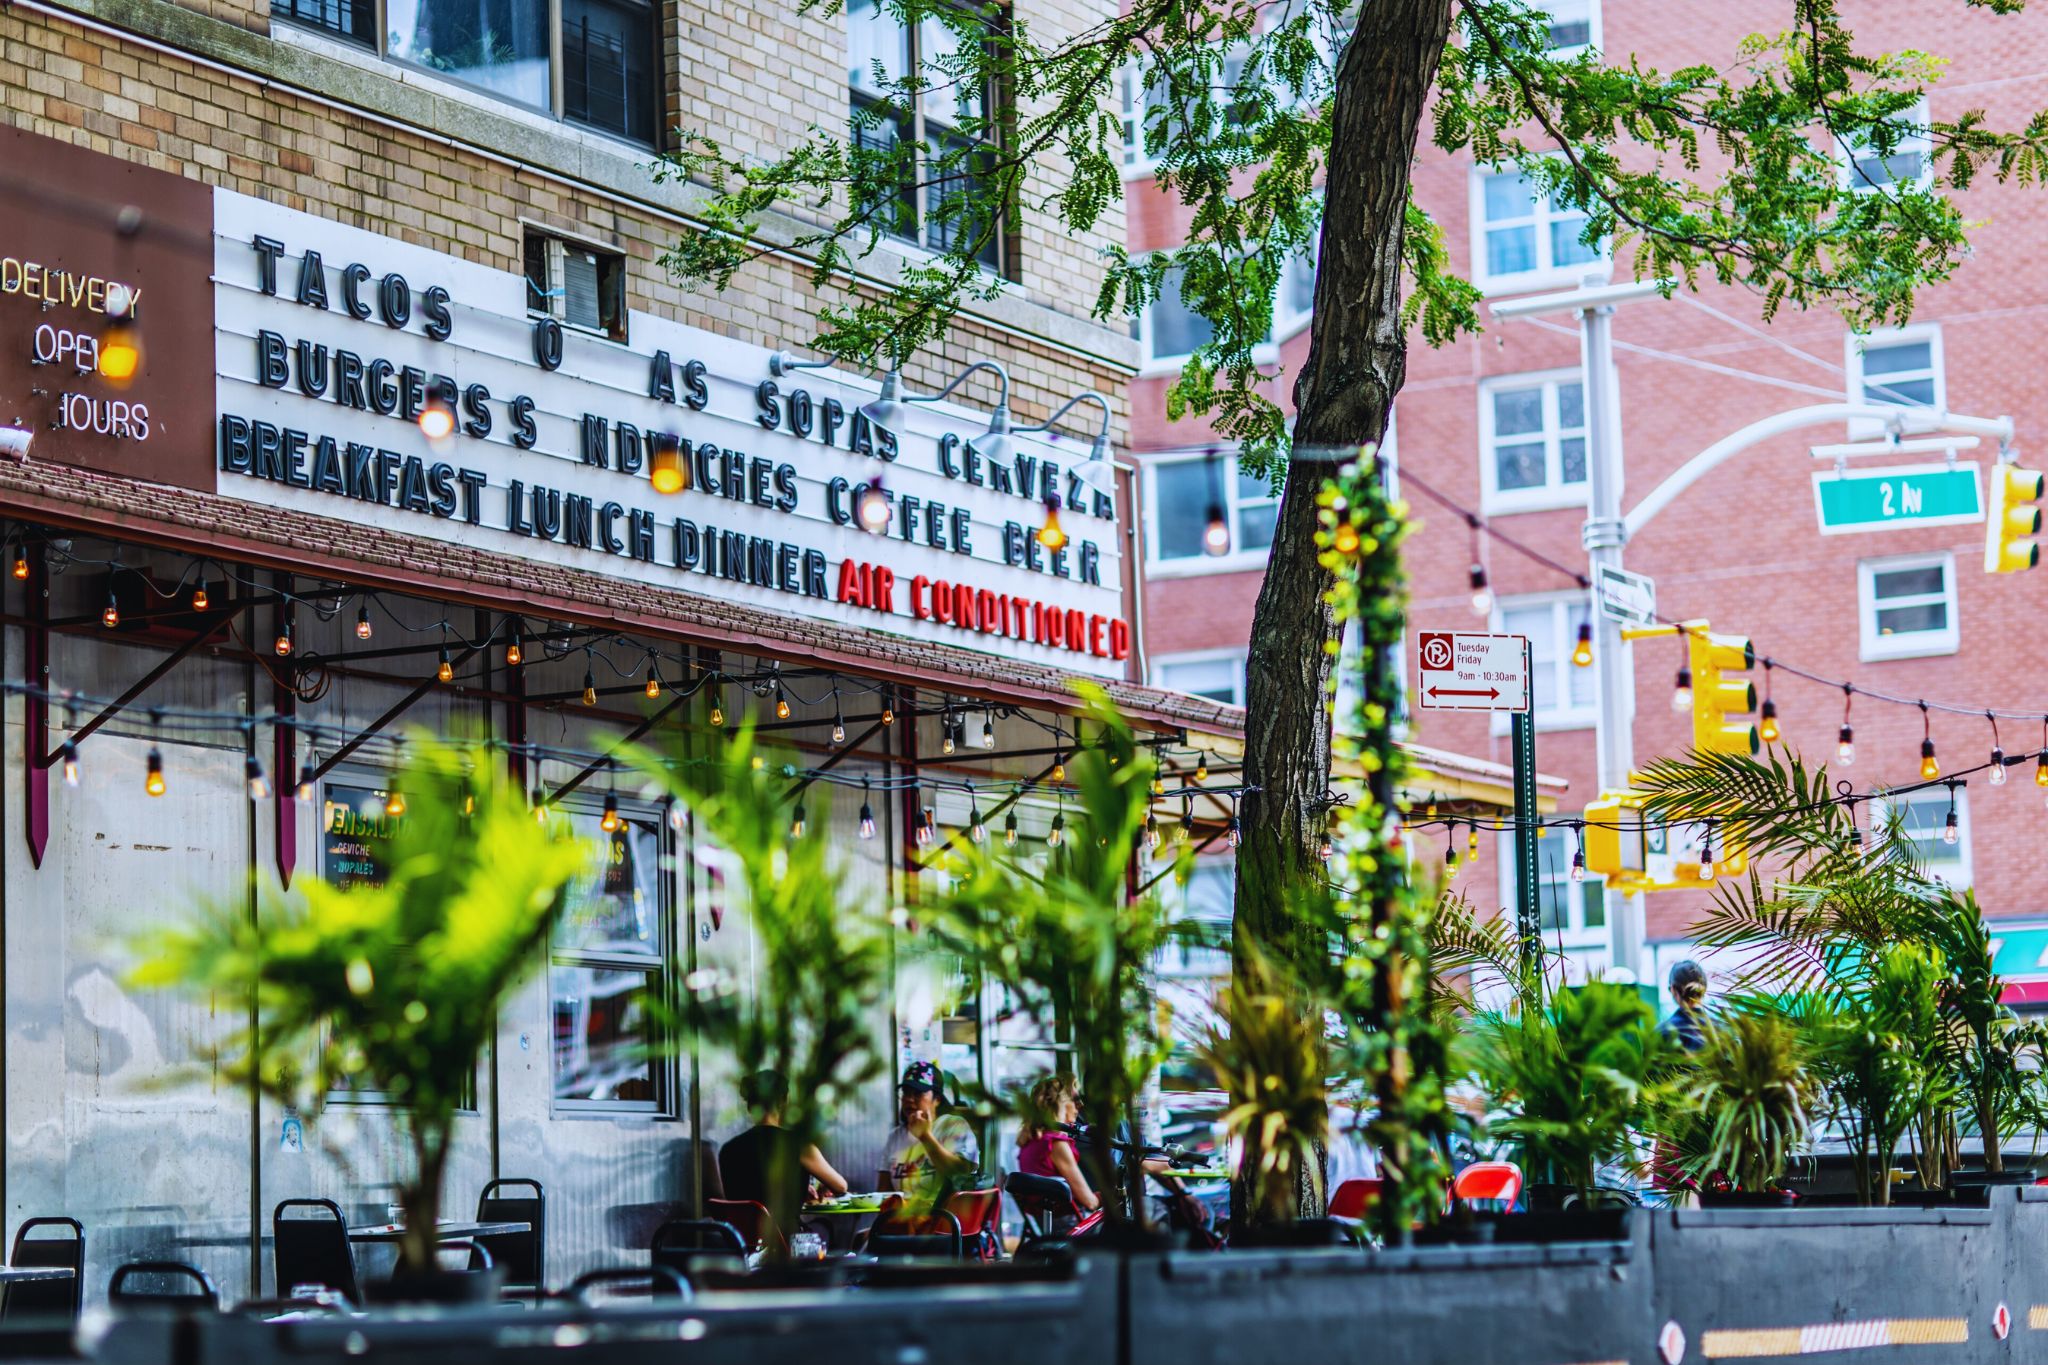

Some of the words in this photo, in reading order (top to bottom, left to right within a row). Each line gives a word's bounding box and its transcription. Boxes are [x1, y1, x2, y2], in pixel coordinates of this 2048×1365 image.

[2, 257, 141, 319] DELIVERY
[253, 234, 452, 342] TACOS
[537, 317, 563, 371] O
[650, 349, 708, 411] AS
[758, 379, 899, 461] SOPAS
[259, 328, 492, 439] BURGERS
[583, 412, 798, 514] NDWICHES
[1004, 520, 1100, 586] BEER
[1879, 481, 1896, 516] 2
[220, 413, 487, 525] BREAKFAST
[510, 479, 656, 563] LUNCH
[674, 517, 828, 599] DINNER
[838, 558, 895, 612] AIR
[911, 574, 1129, 660] CONDITIONED
[1457, 654, 1482, 666] Friday
[1458, 642, 1489, 654] Tuesday
[1457, 671, 1476, 681] 9am
[1483, 671, 1517, 682] 10:30am
[338, 842, 371, 856] CEVICHE
